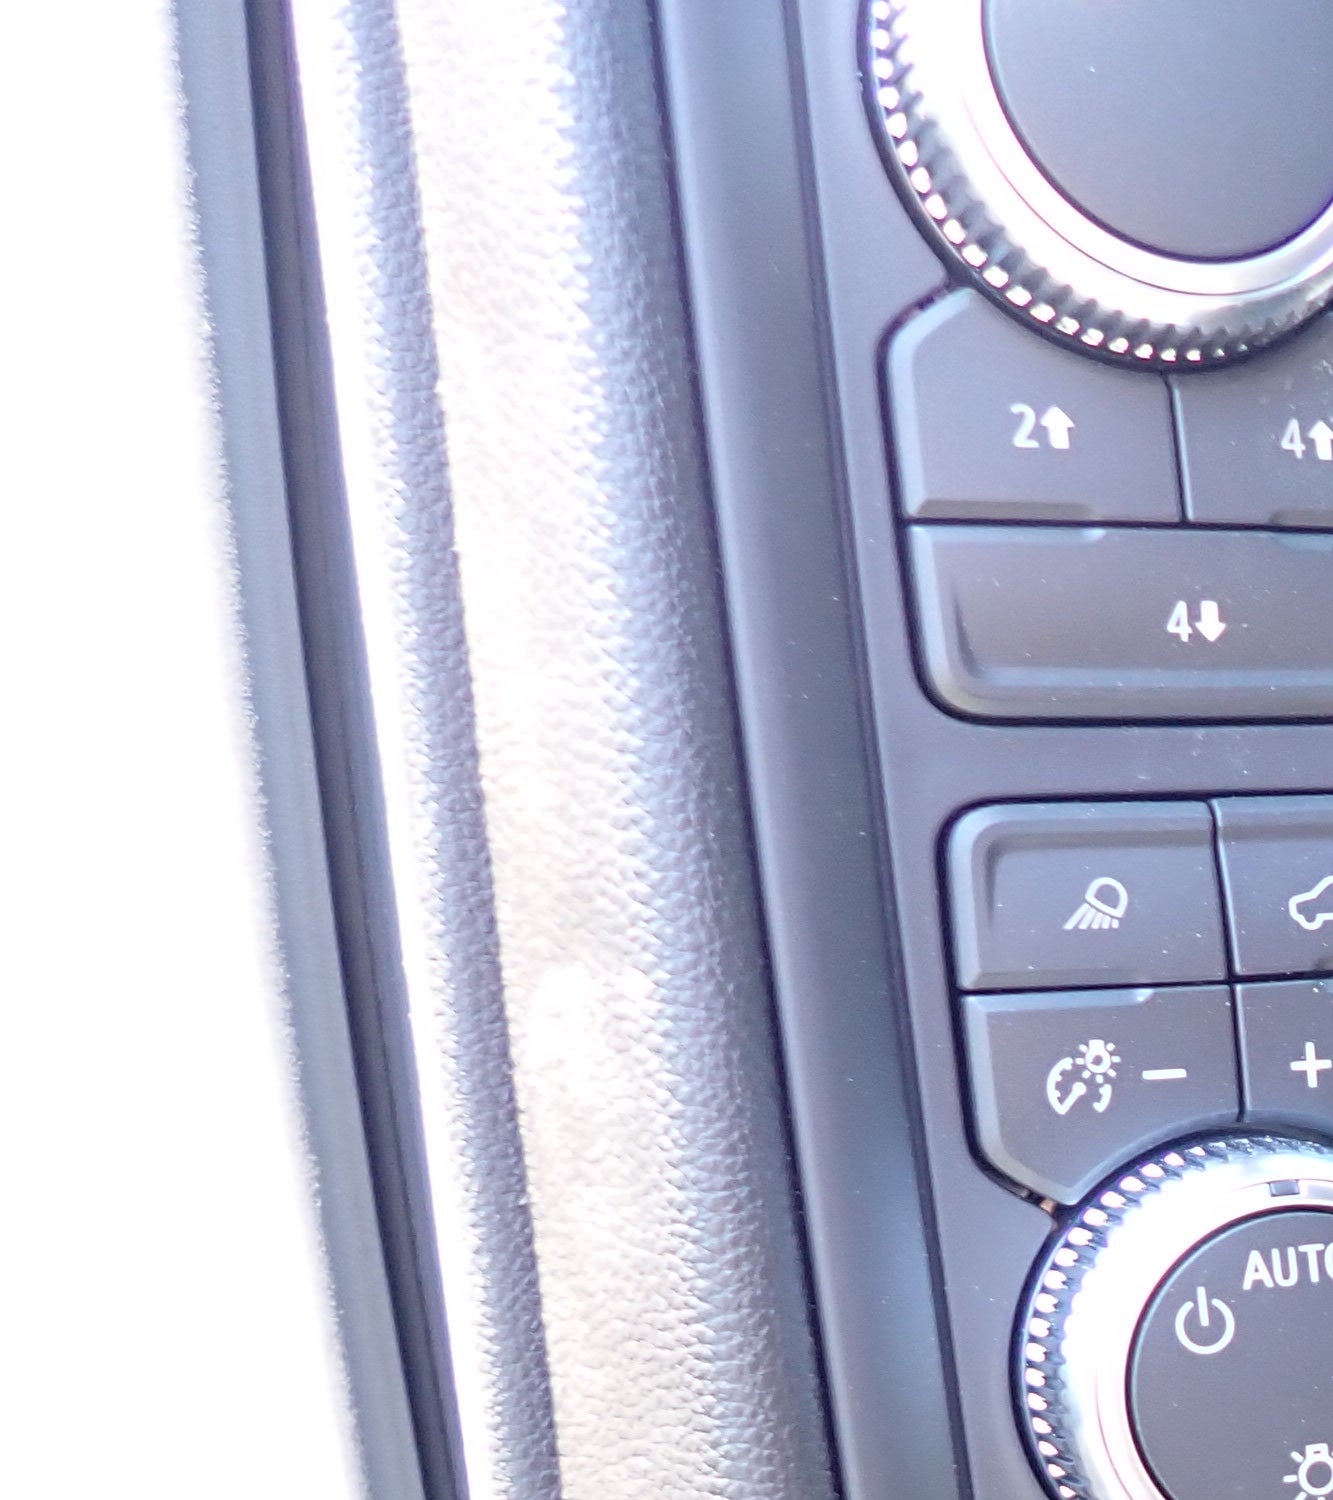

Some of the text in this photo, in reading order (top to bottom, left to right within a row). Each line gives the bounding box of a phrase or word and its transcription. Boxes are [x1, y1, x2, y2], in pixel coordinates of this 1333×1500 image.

[1010, 403, 1041, 449] 2
[1281, 419, 1306, 460] 4
[1166, 600, 1193, 642] 4
